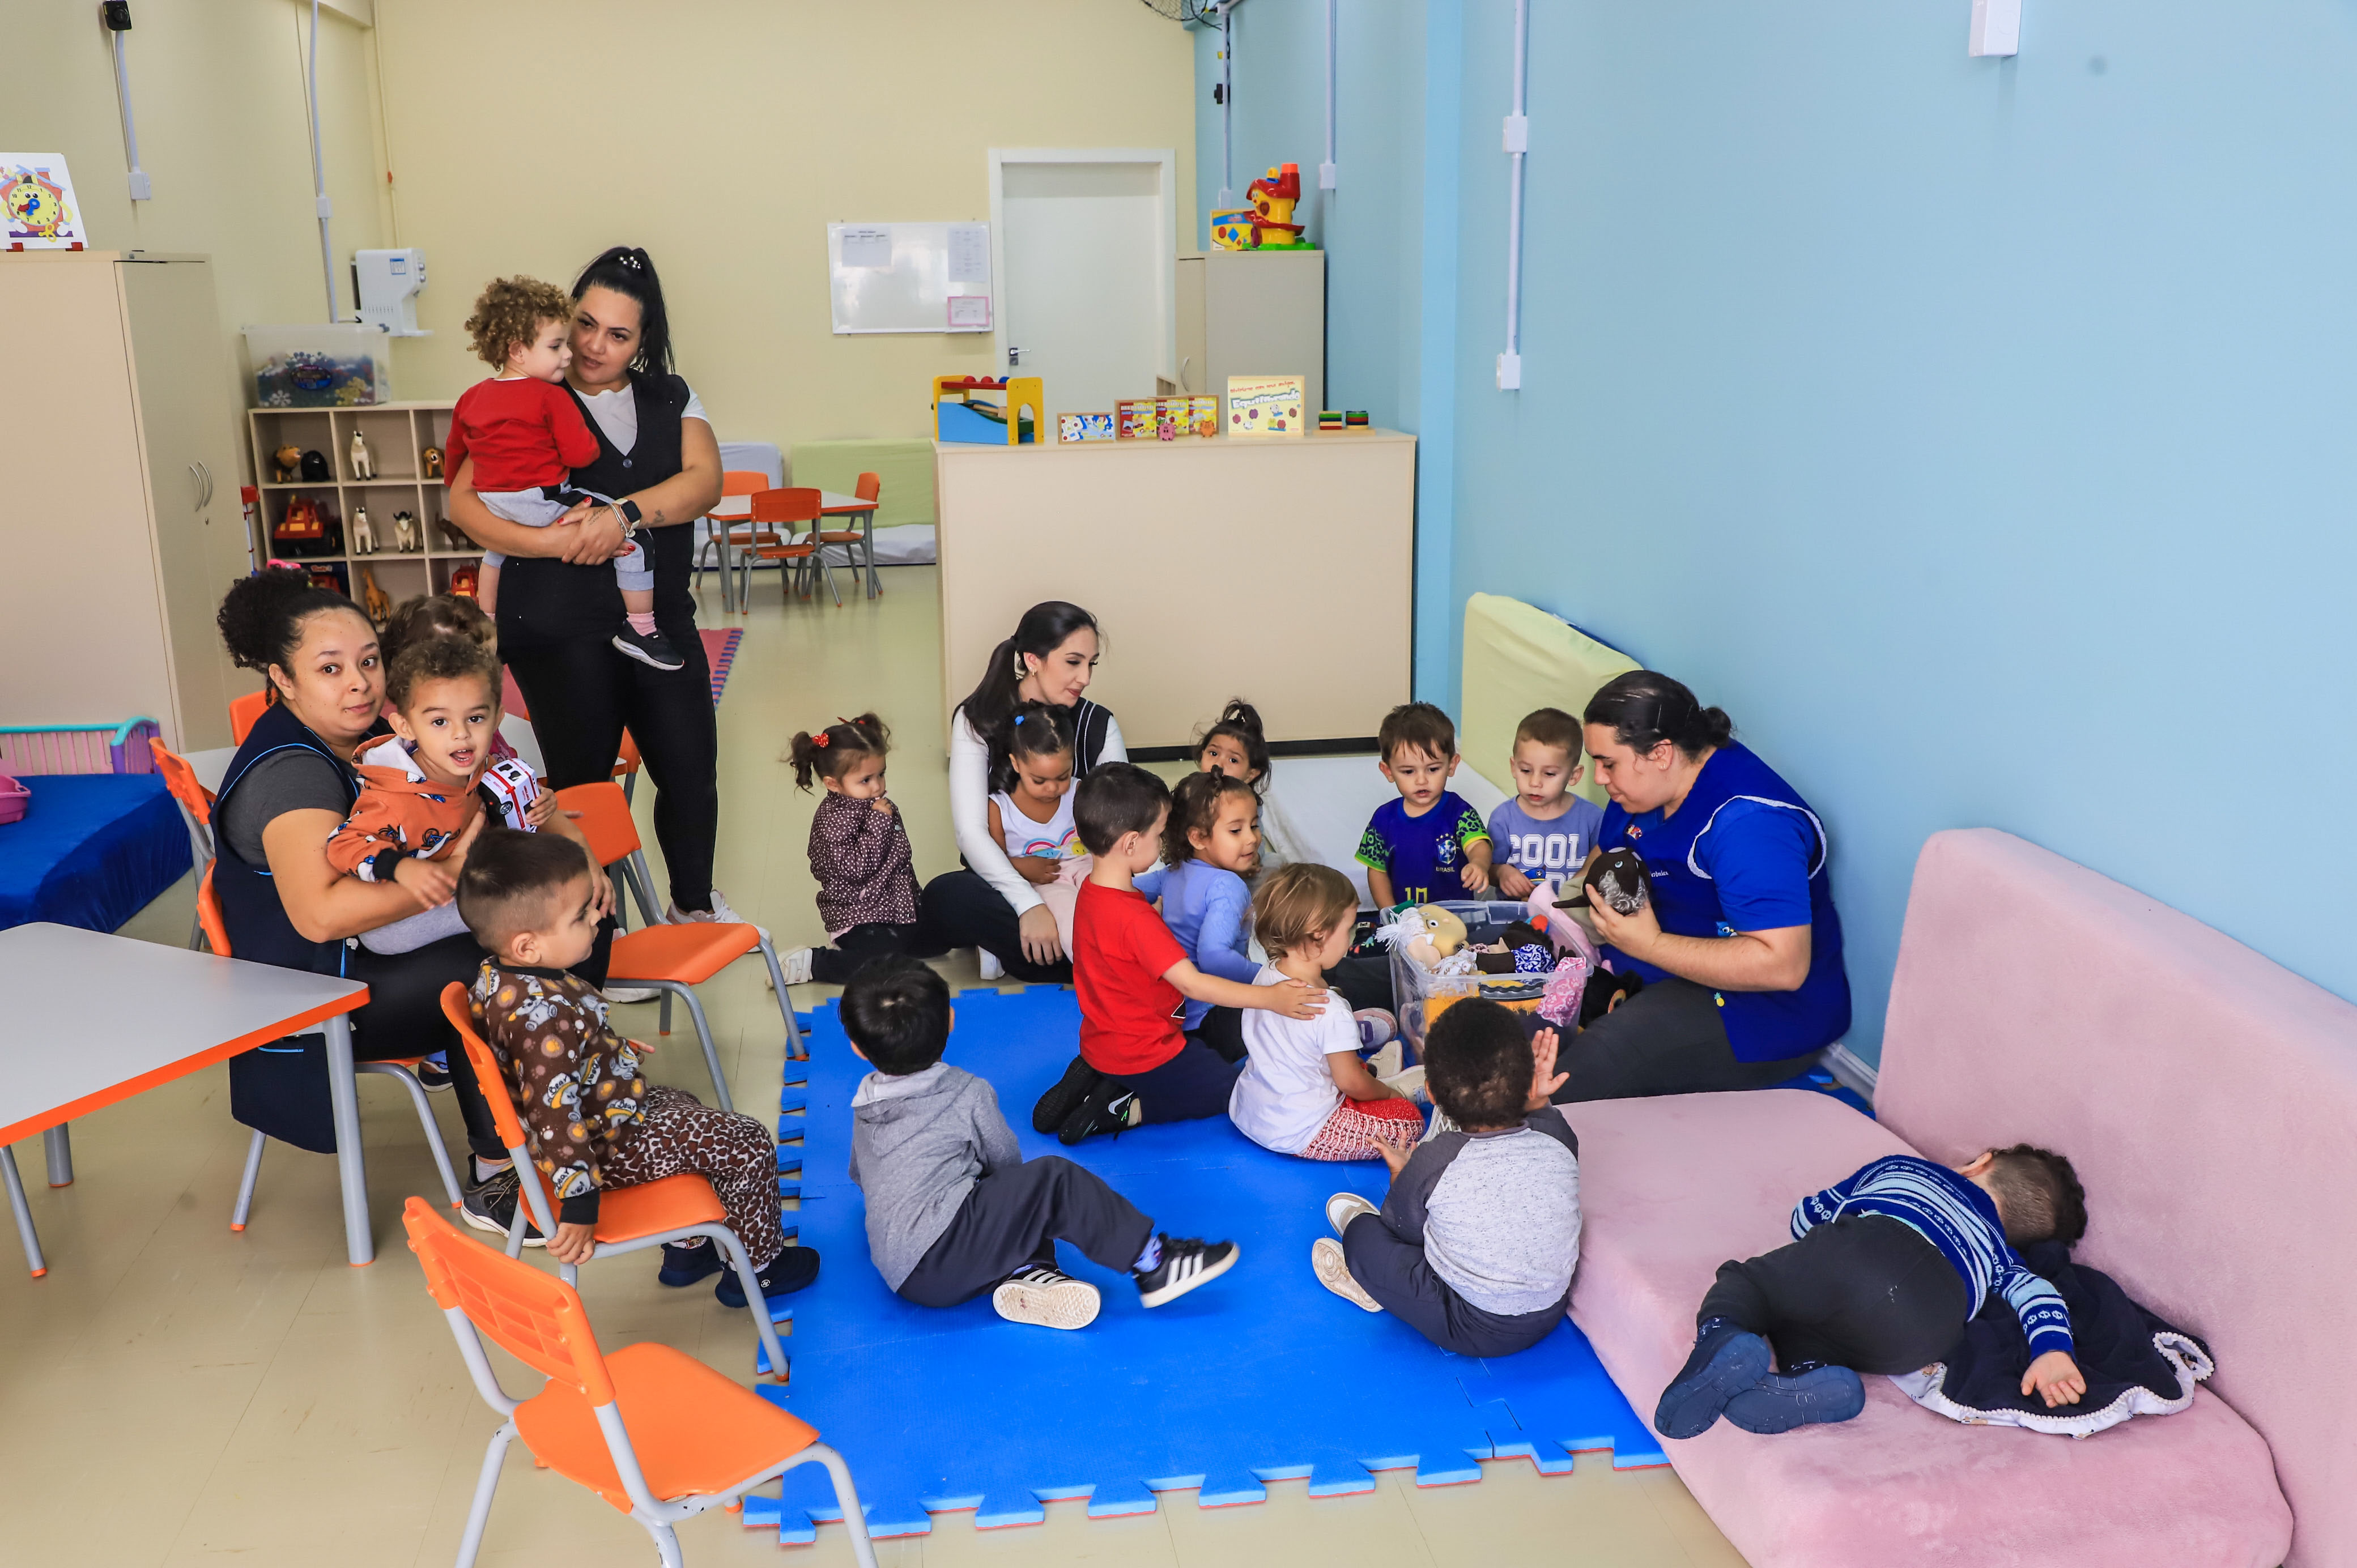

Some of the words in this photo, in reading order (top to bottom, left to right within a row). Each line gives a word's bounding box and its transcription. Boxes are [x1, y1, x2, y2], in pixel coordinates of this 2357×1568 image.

[1507, 833, 1588, 869] COOL
[588, 1061, 599, 1084] Bear
[549, 1075, 568, 1096] Bear
[616, 1099, 636, 1111] Bear
